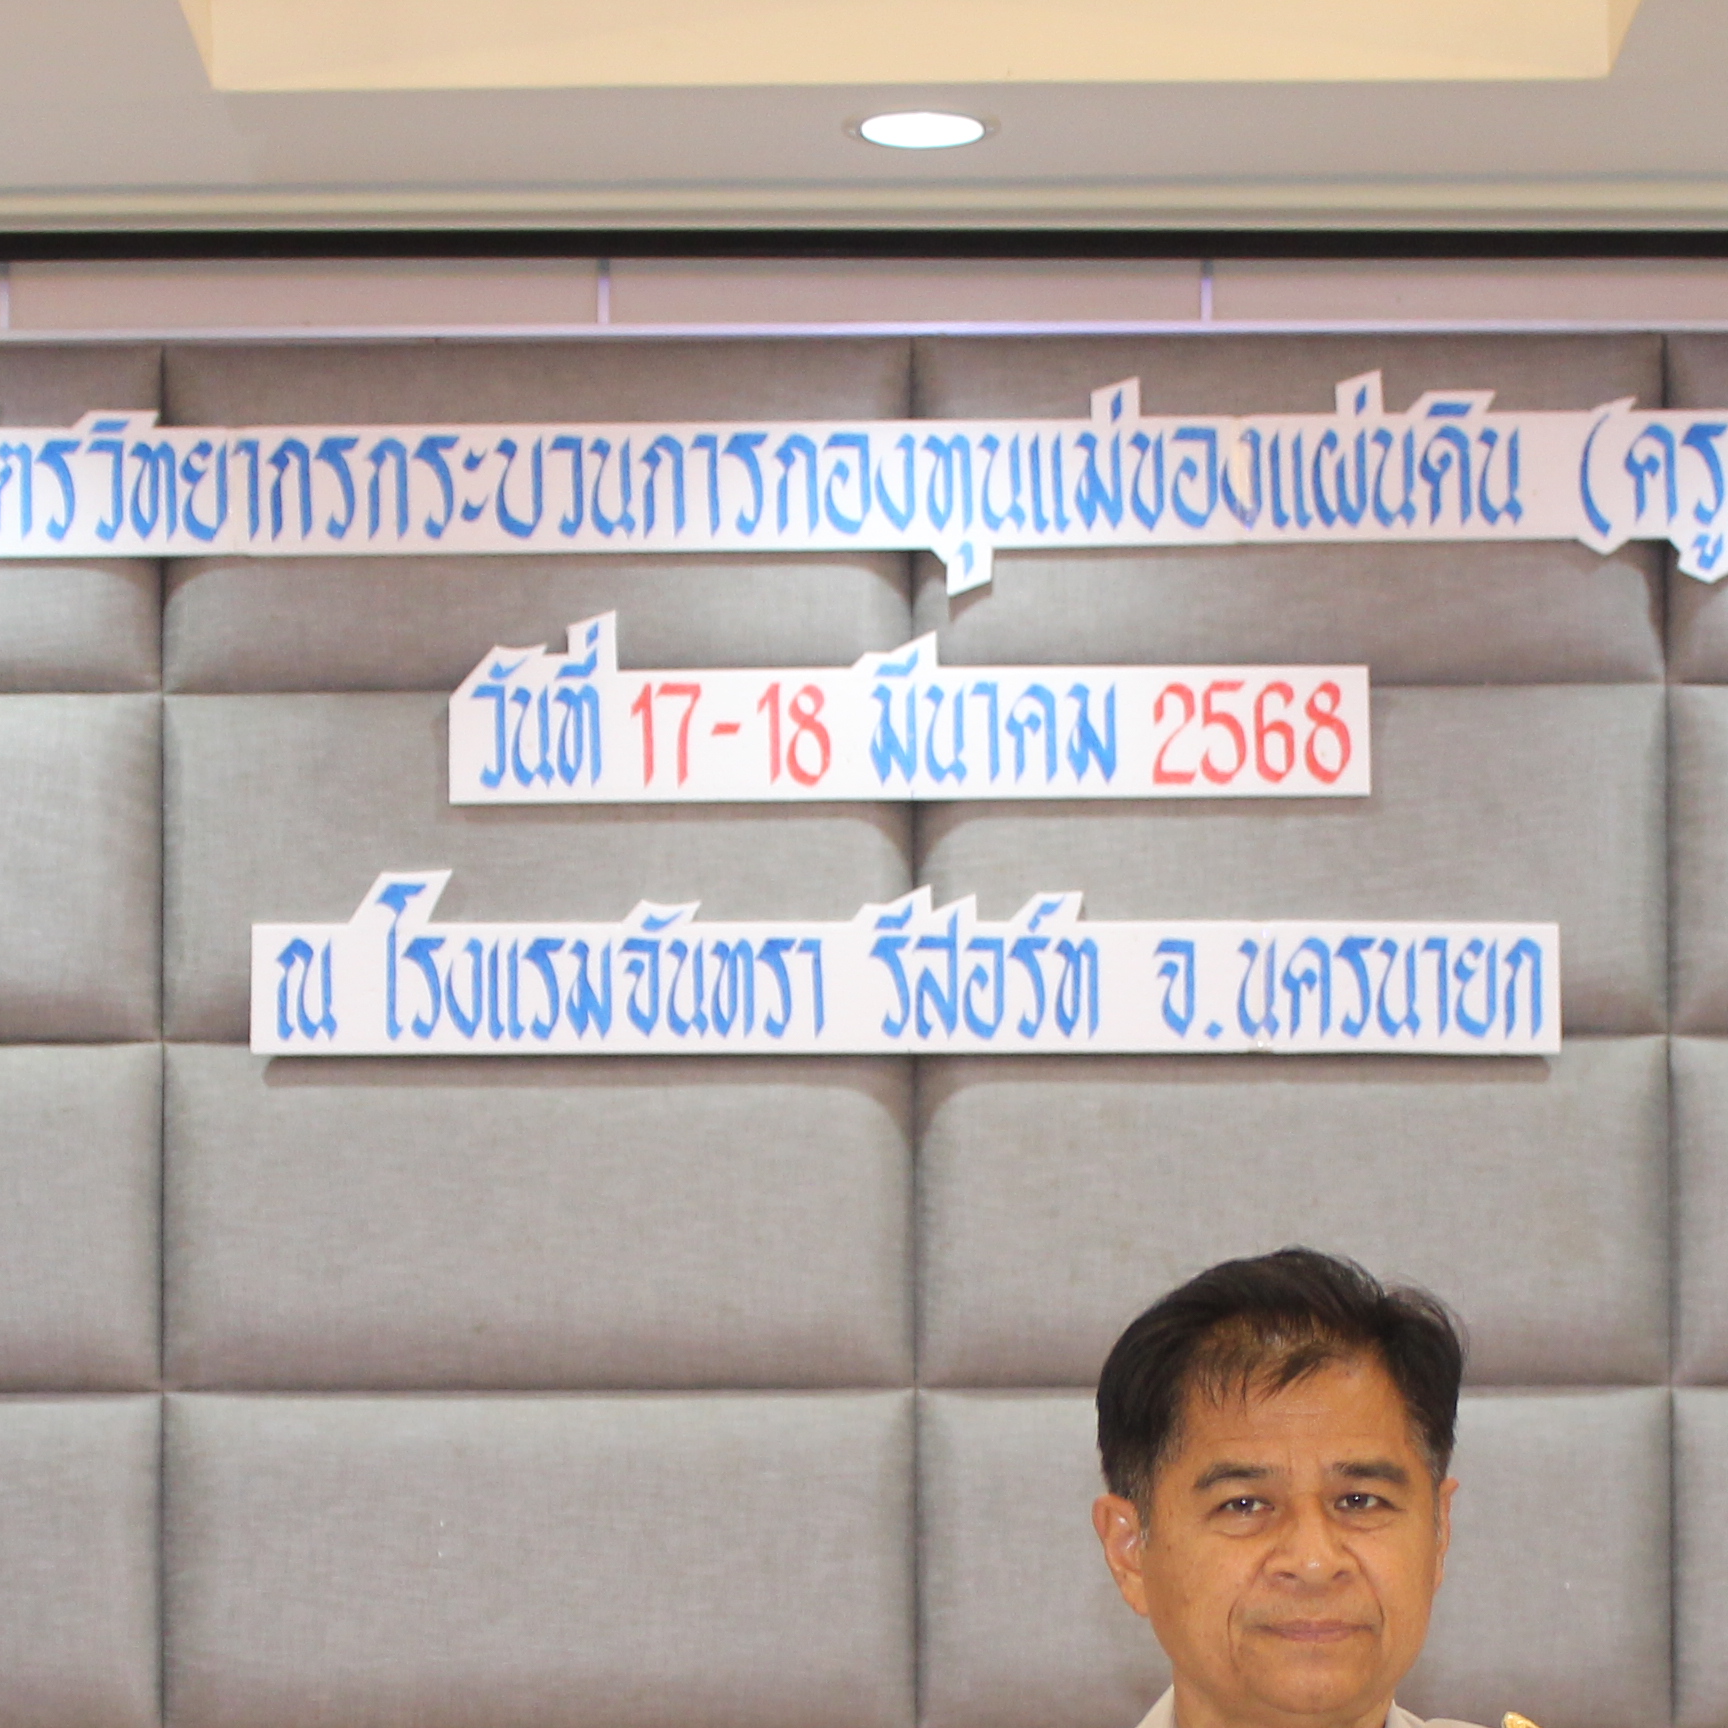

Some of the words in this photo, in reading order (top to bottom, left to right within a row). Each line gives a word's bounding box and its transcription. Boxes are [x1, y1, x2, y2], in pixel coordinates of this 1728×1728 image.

[1580, 412, 1728, 571] (ครู
[473, 620, 602, 788] วันที่
[631, 681, 832, 787] 17-18
[869, 652, 1118, 787] มีนาคม
[1152, 680, 1353, 785] 2568
[277, 936, 338, 1040] ณ
[379, 881, 825, 1041] โรงแรมจันทรา
[870, 900, 1100, 1040] รีสอร์ท
[1156, 936, 1544, 1039] จ.นครนายก
